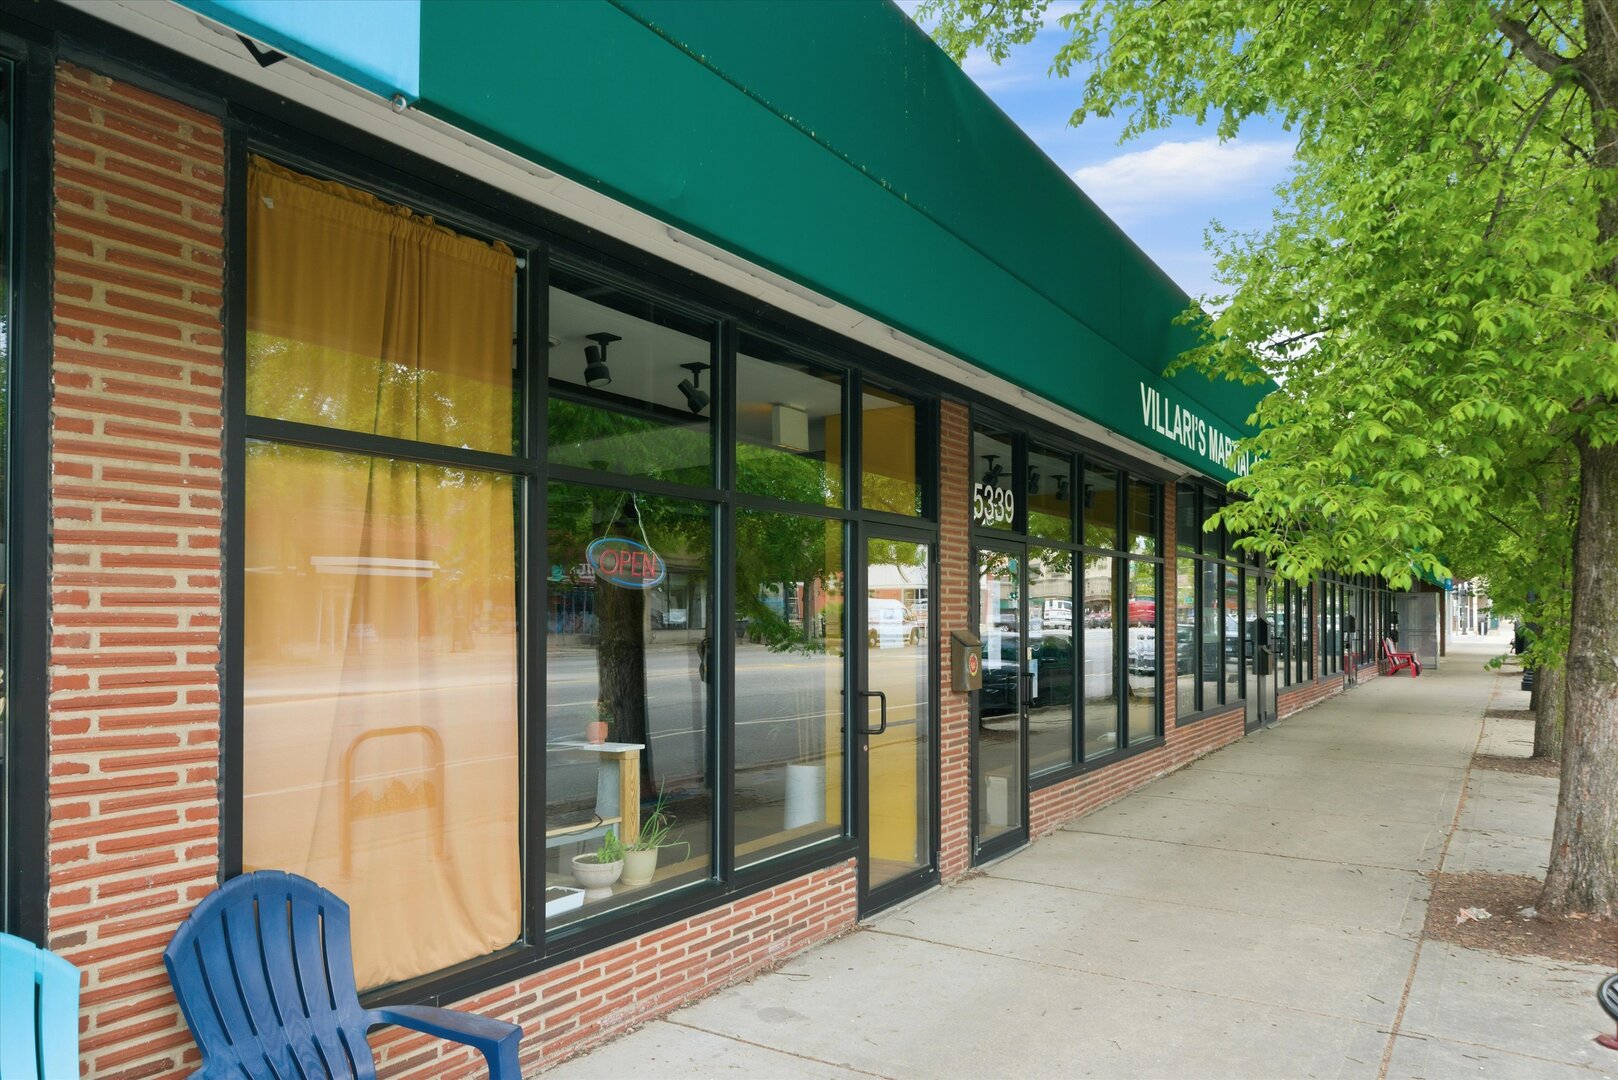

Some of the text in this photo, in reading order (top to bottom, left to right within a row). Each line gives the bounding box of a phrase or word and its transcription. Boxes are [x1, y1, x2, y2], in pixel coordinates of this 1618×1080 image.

[1140, 382, 1206, 456] VILLARI'S
[973, 482, 1014, 524] 5339
[599, 549, 657, 578] OPEN
